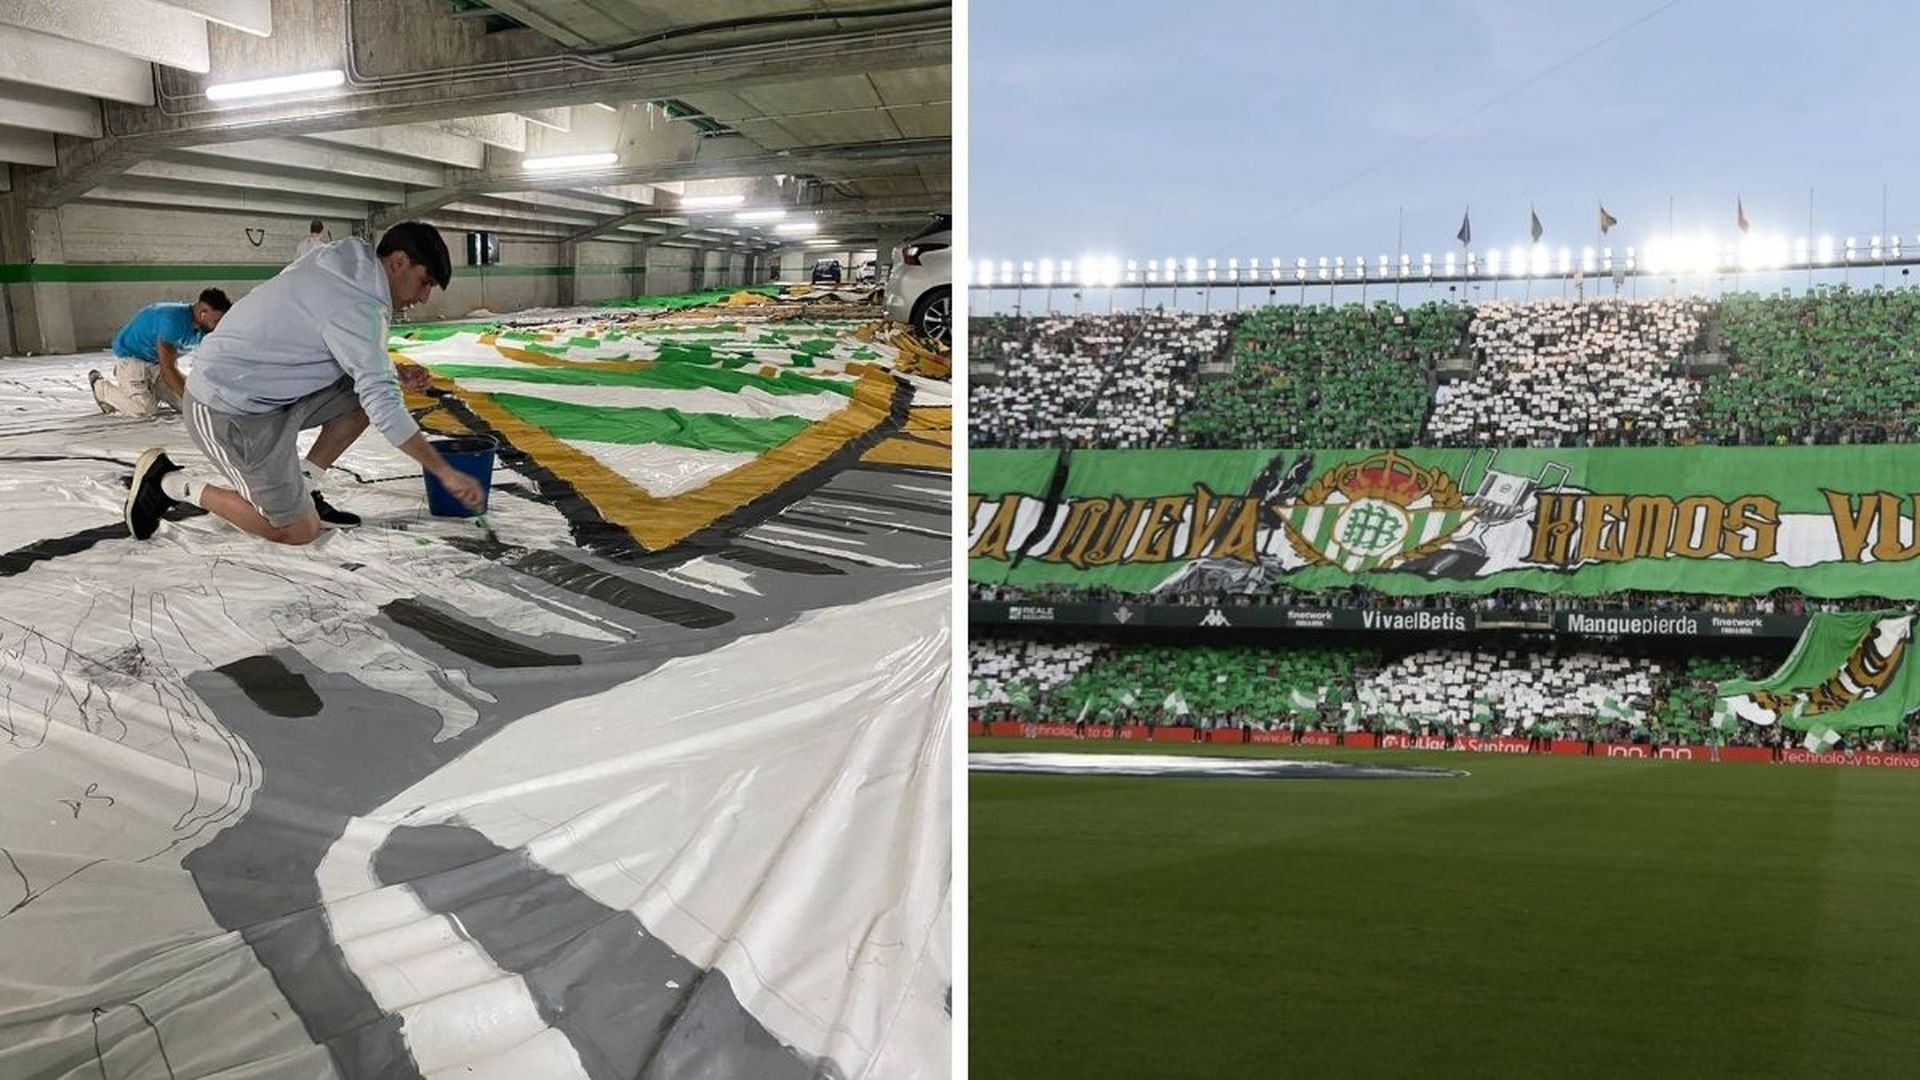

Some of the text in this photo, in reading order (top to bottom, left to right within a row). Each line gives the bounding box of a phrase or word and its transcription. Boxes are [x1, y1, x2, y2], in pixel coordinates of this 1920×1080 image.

[1040, 481, 1261, 570] NUEVA
[1520, 490, 1781, 569] HEMOS
[1362, 610, 1466, 631] VivaelBetis
[1568, 614, 1698, 635] Manquepierda
